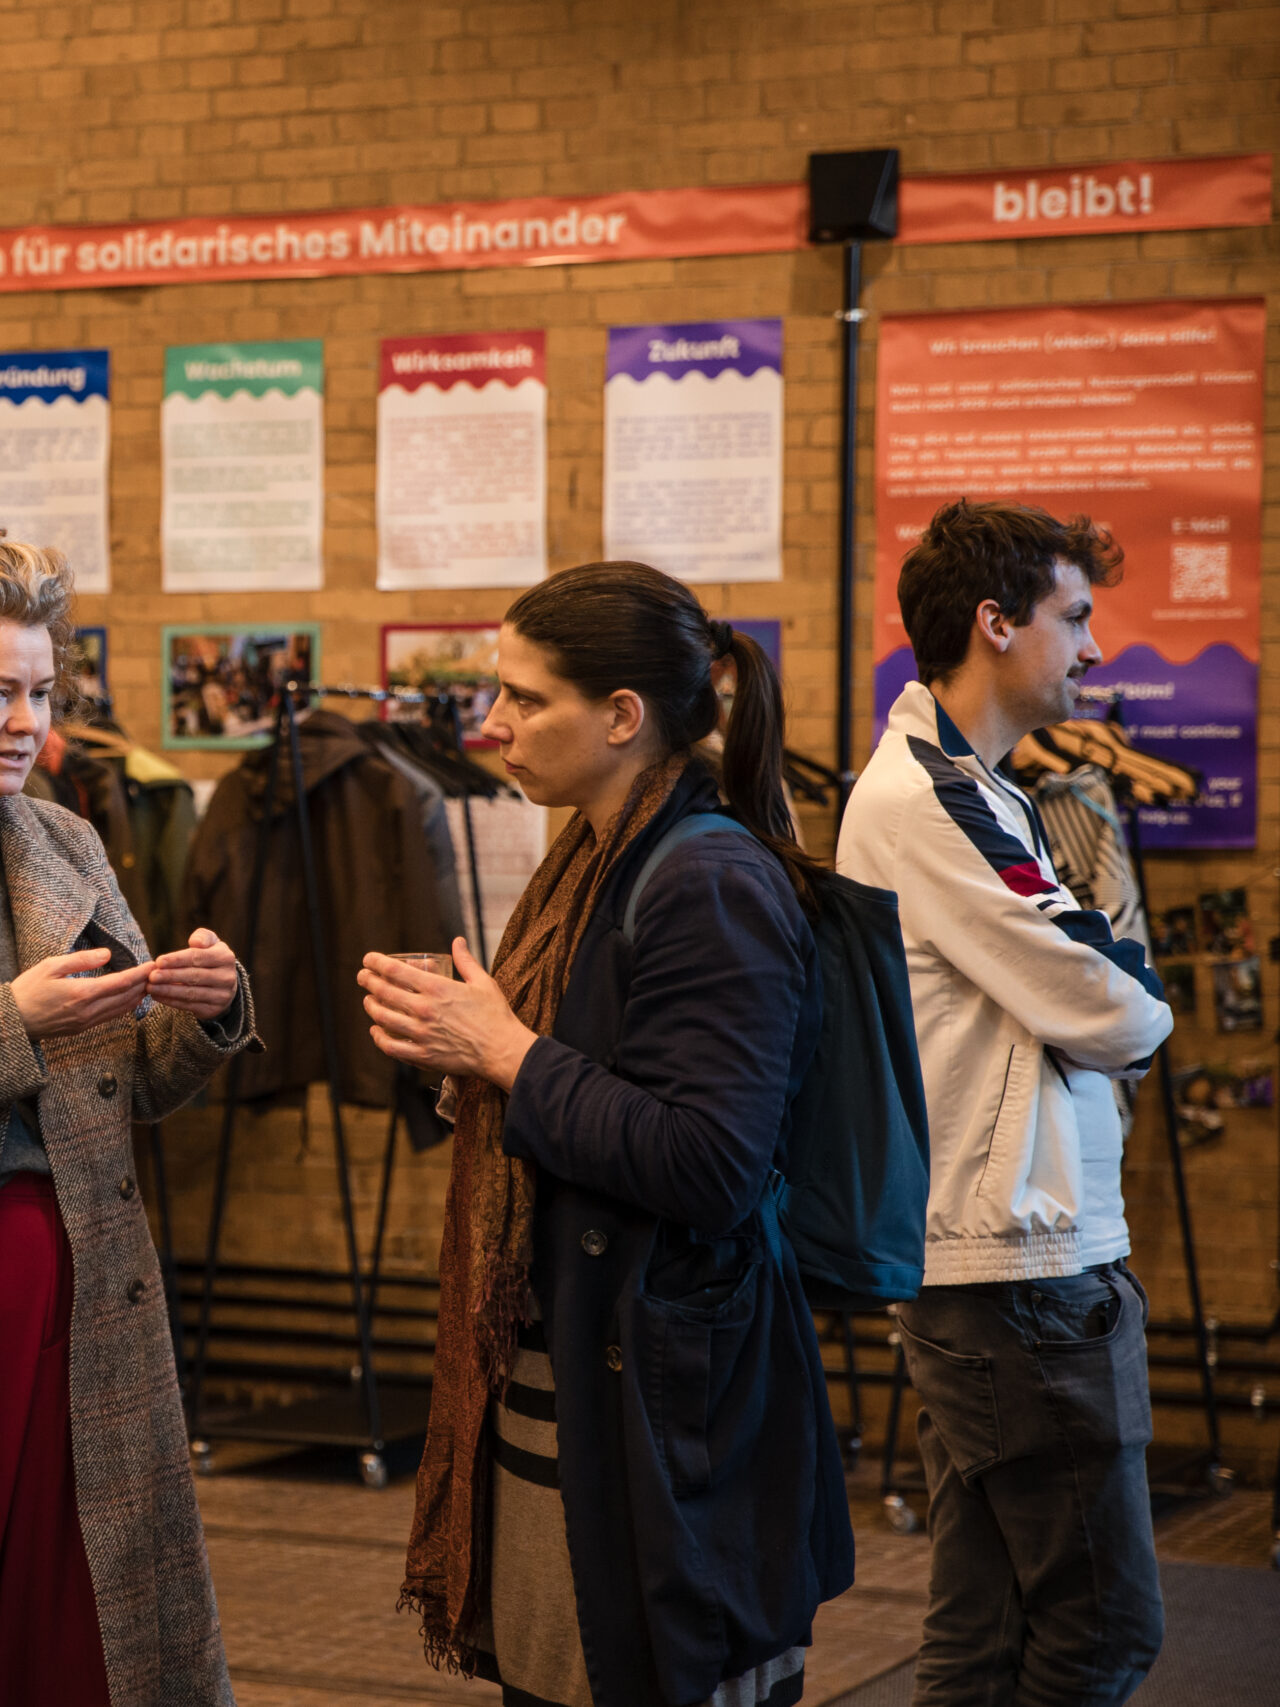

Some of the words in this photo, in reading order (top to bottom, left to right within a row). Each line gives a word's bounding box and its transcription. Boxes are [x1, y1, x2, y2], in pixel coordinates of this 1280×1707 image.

[12, 236, 68, 276] für
[76, 225, 350, 272] solidarisches
[358, 207, 626, 258] Miteinander
[993, 174, 1154, 221] bleibt!
[392, 344, 534, 374] Wirksamkeit
[648, 335, 740, 363] Zukunft
[185, 358, 303, 381] Wachstum
